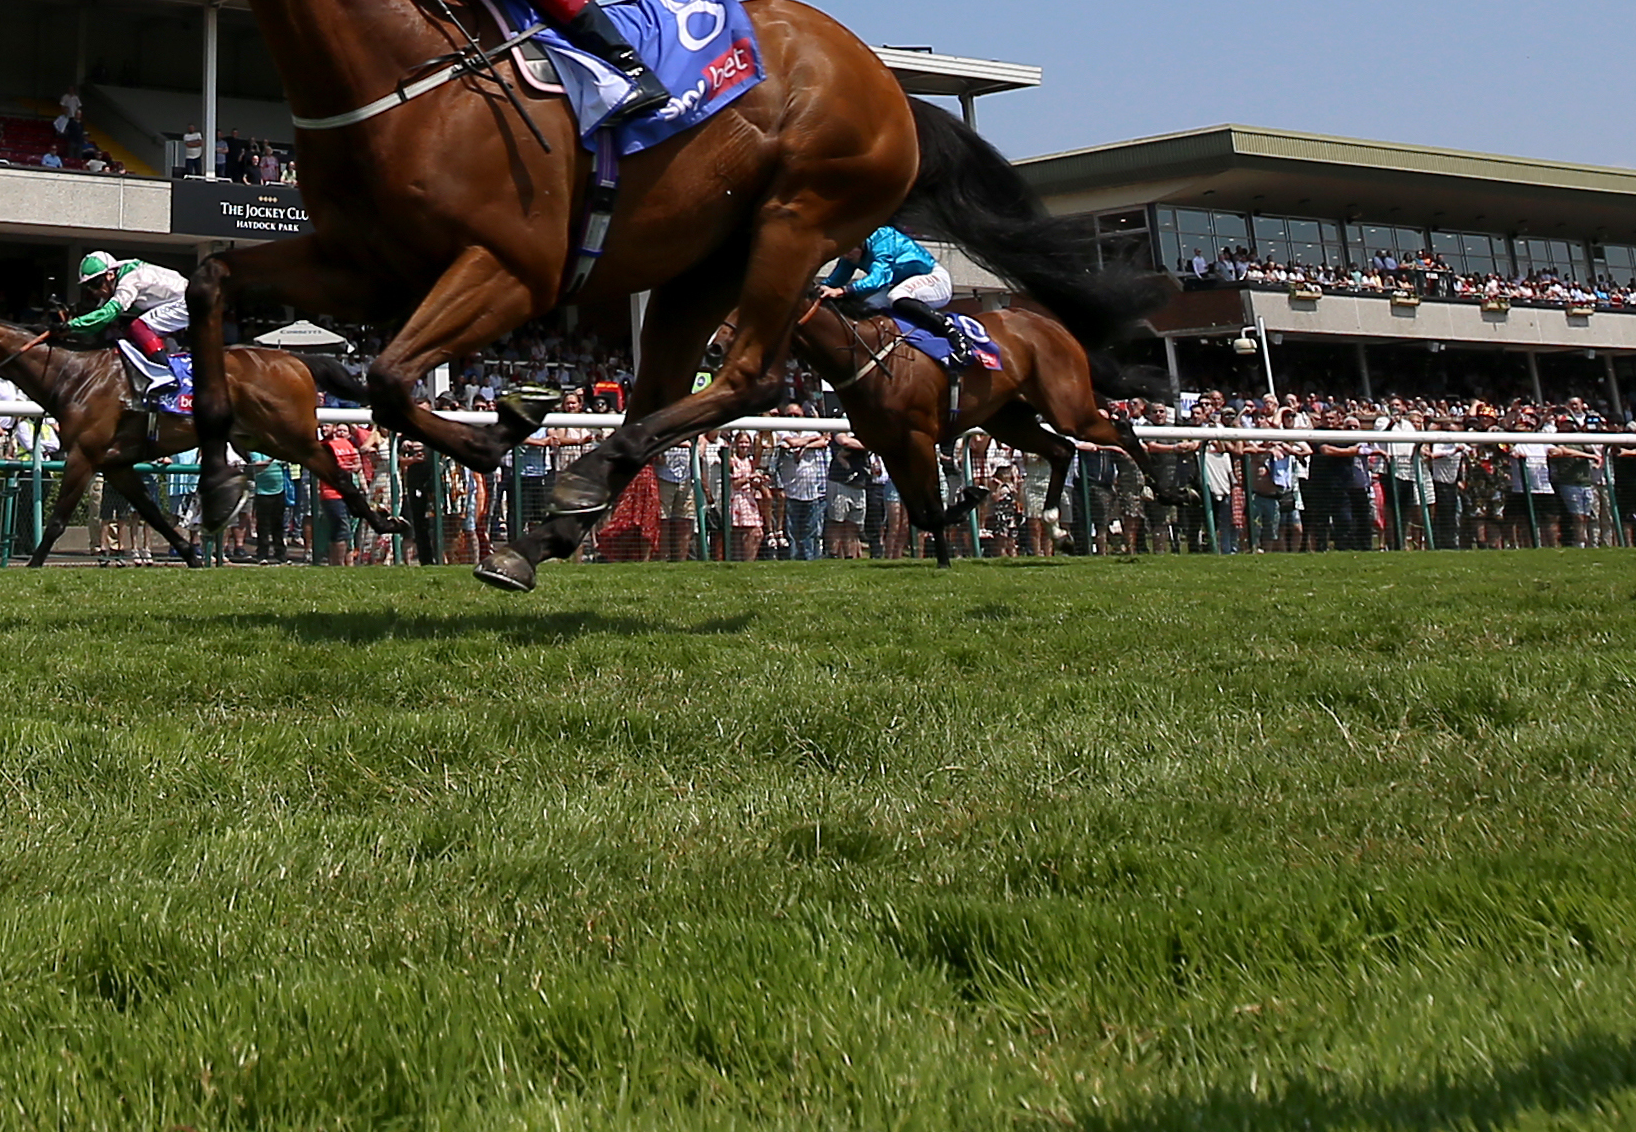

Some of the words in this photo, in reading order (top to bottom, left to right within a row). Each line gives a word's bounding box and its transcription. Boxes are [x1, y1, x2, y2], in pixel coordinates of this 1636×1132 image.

[709, 48, 748, 90] bet
[220, 201, 244, 216] THE
[245, 203, 286, 220] JOCKEY
[286, 206, 310, 221] CLU
[236, 220, 276, 231] HAYDOCK
[278, 222, 300, 232] PARK
